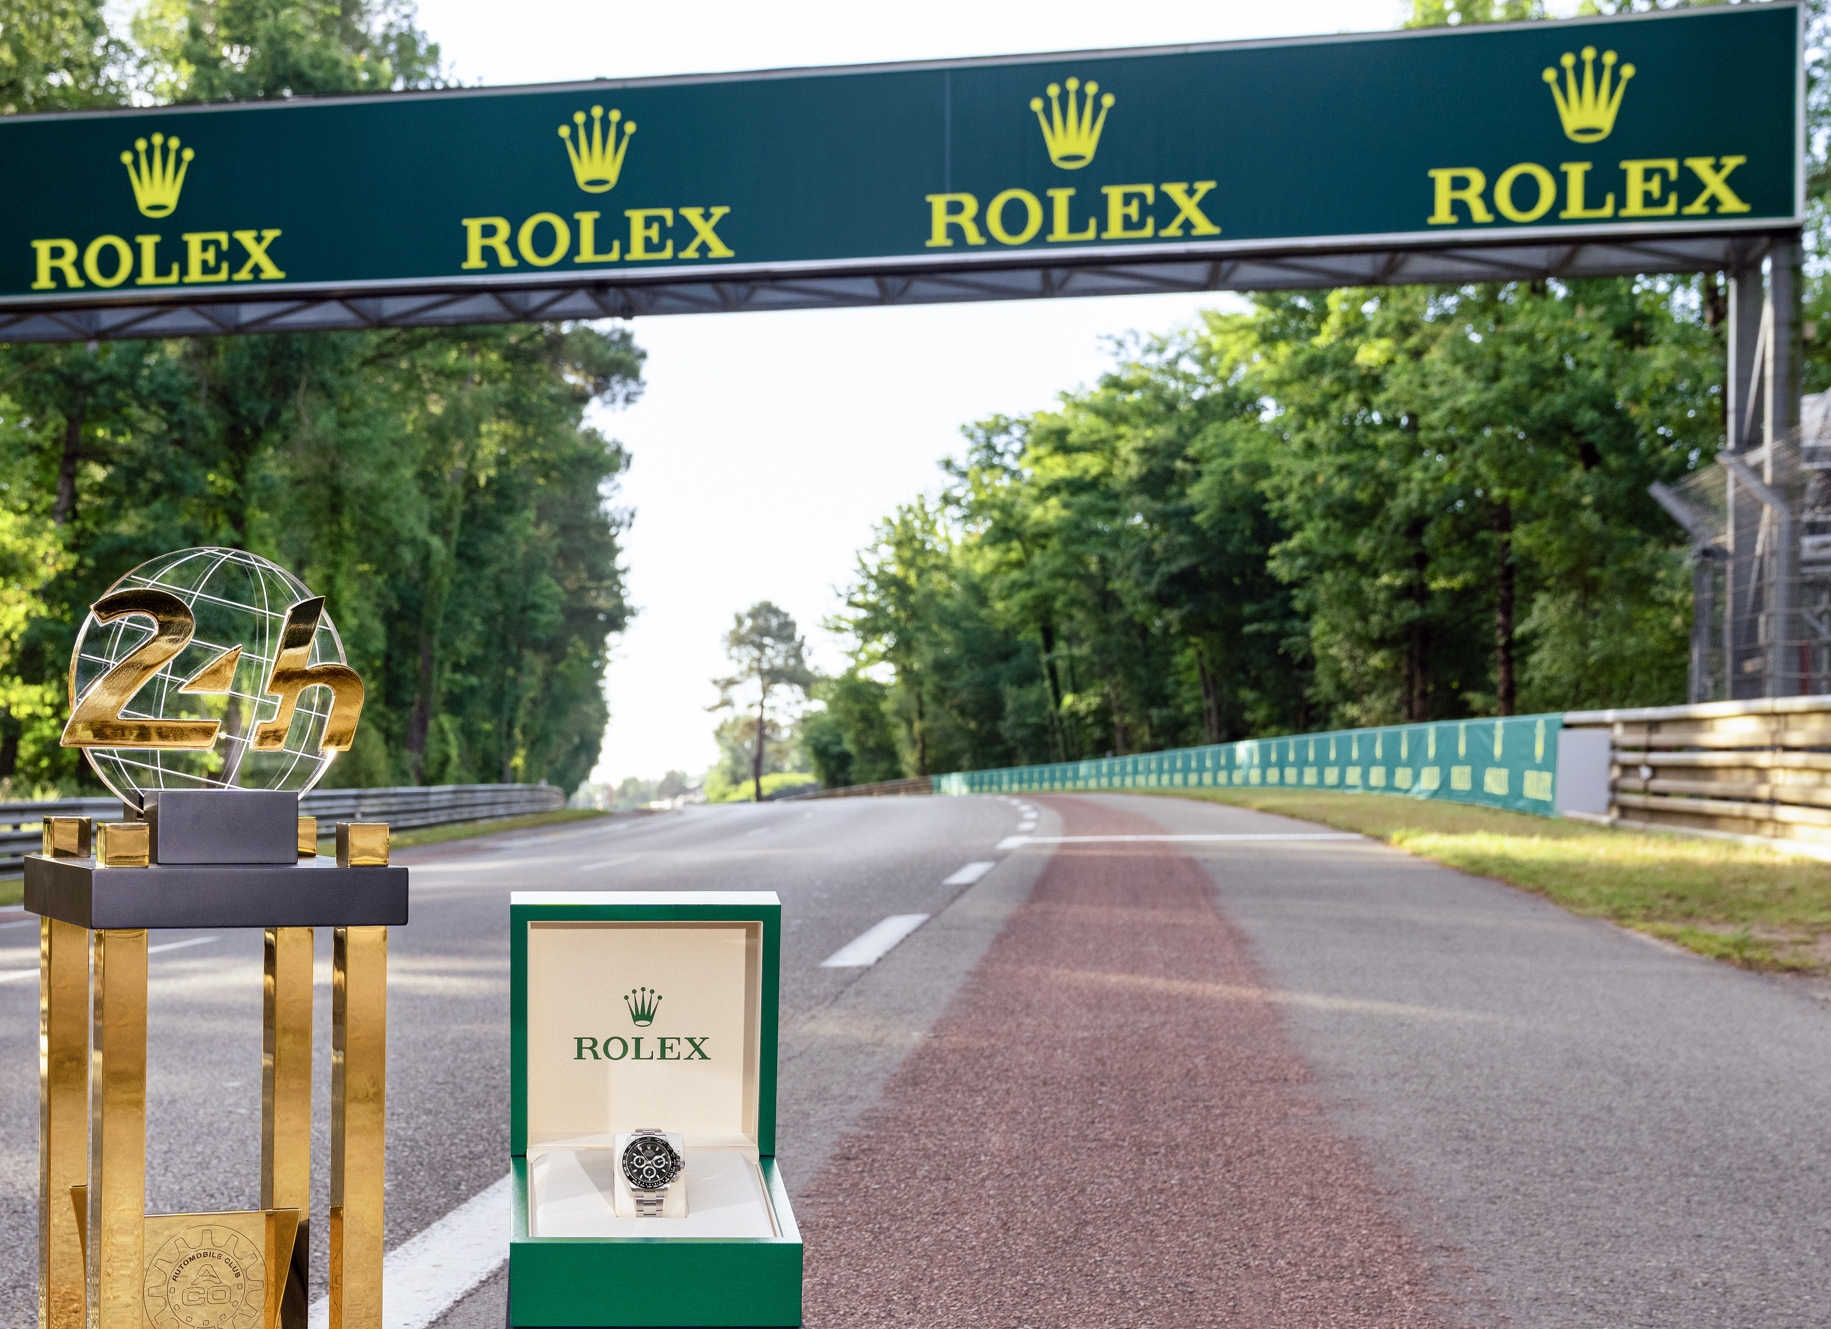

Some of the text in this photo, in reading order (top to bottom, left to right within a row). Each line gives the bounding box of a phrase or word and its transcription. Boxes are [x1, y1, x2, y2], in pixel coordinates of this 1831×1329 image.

[925, 180, 1221, 247] ROLEX
[1428, 154, 1751, 226] ROLEX
[31, 228, 286, 290] ROLEX
[461, 205, 735, 270] ROLEX
[573, 1036, 711, 1061] ROLEX
[172, 1251, 241, 1282] AUTOMOBILE CLUB
